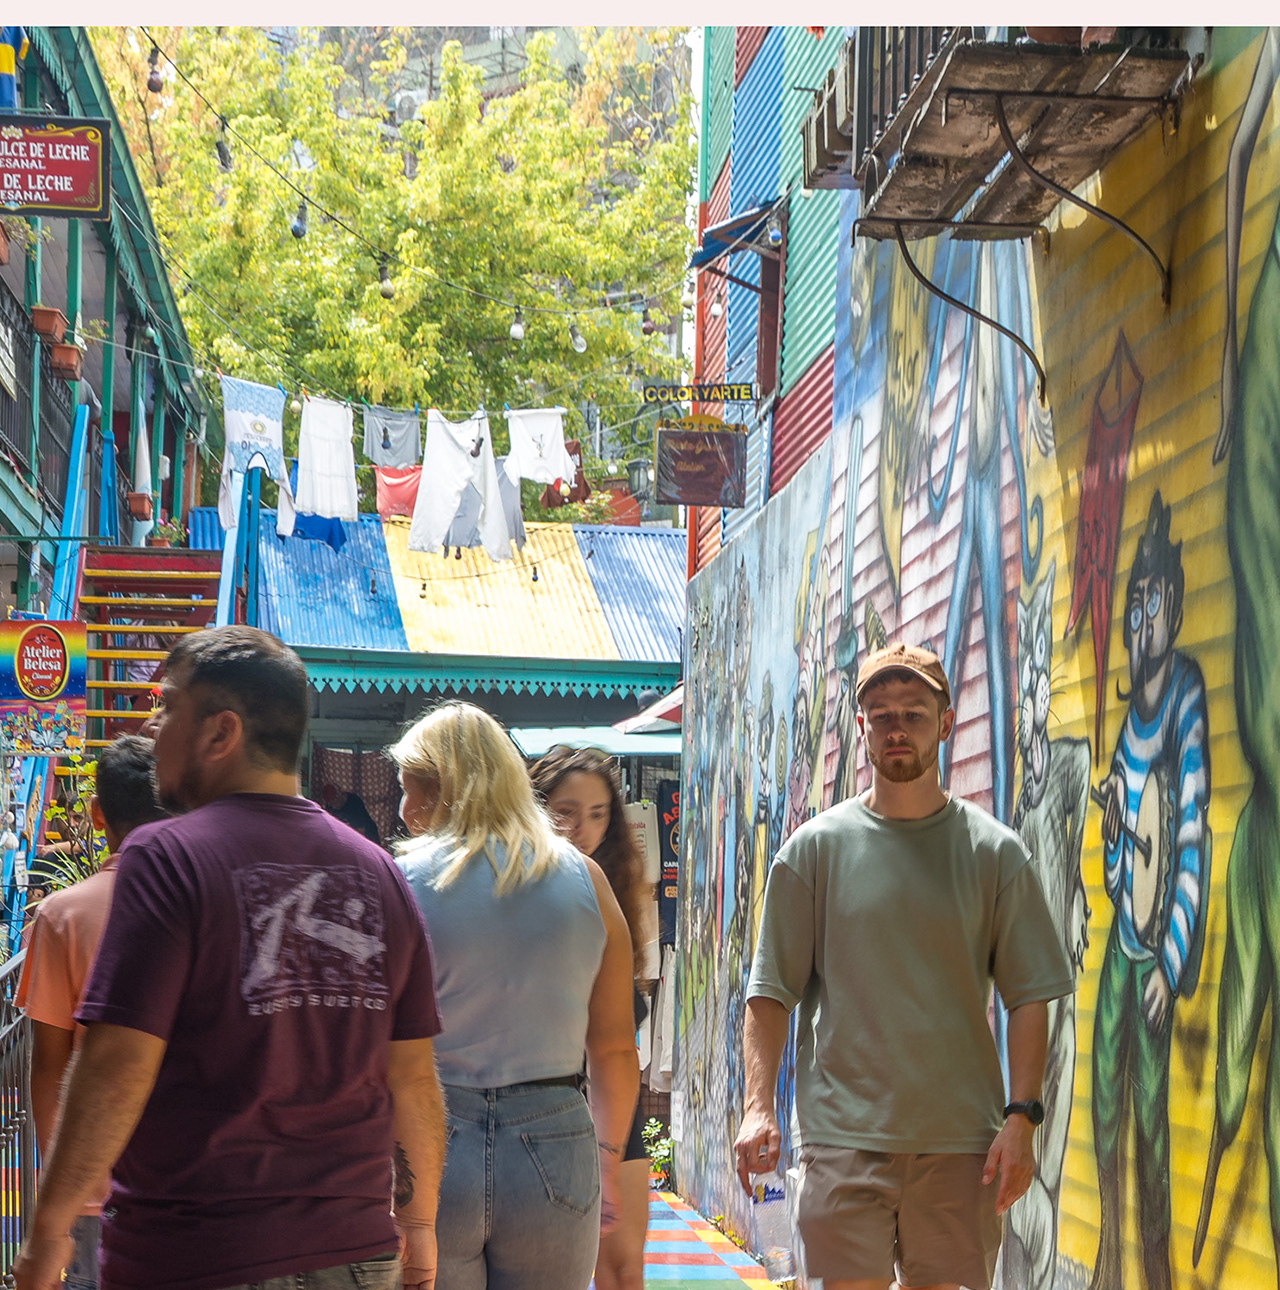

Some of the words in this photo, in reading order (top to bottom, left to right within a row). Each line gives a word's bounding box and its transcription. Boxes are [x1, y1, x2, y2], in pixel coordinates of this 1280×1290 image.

[29, 142, 46, 158] DE
[48, 143, 90, 161] LECHE
[3, 173, 22, 189] DE
[27, 174, 73, 191] LECHE
[22, 646, 62, 659] Atelier
[23, 658, 61, 671] Belesa
